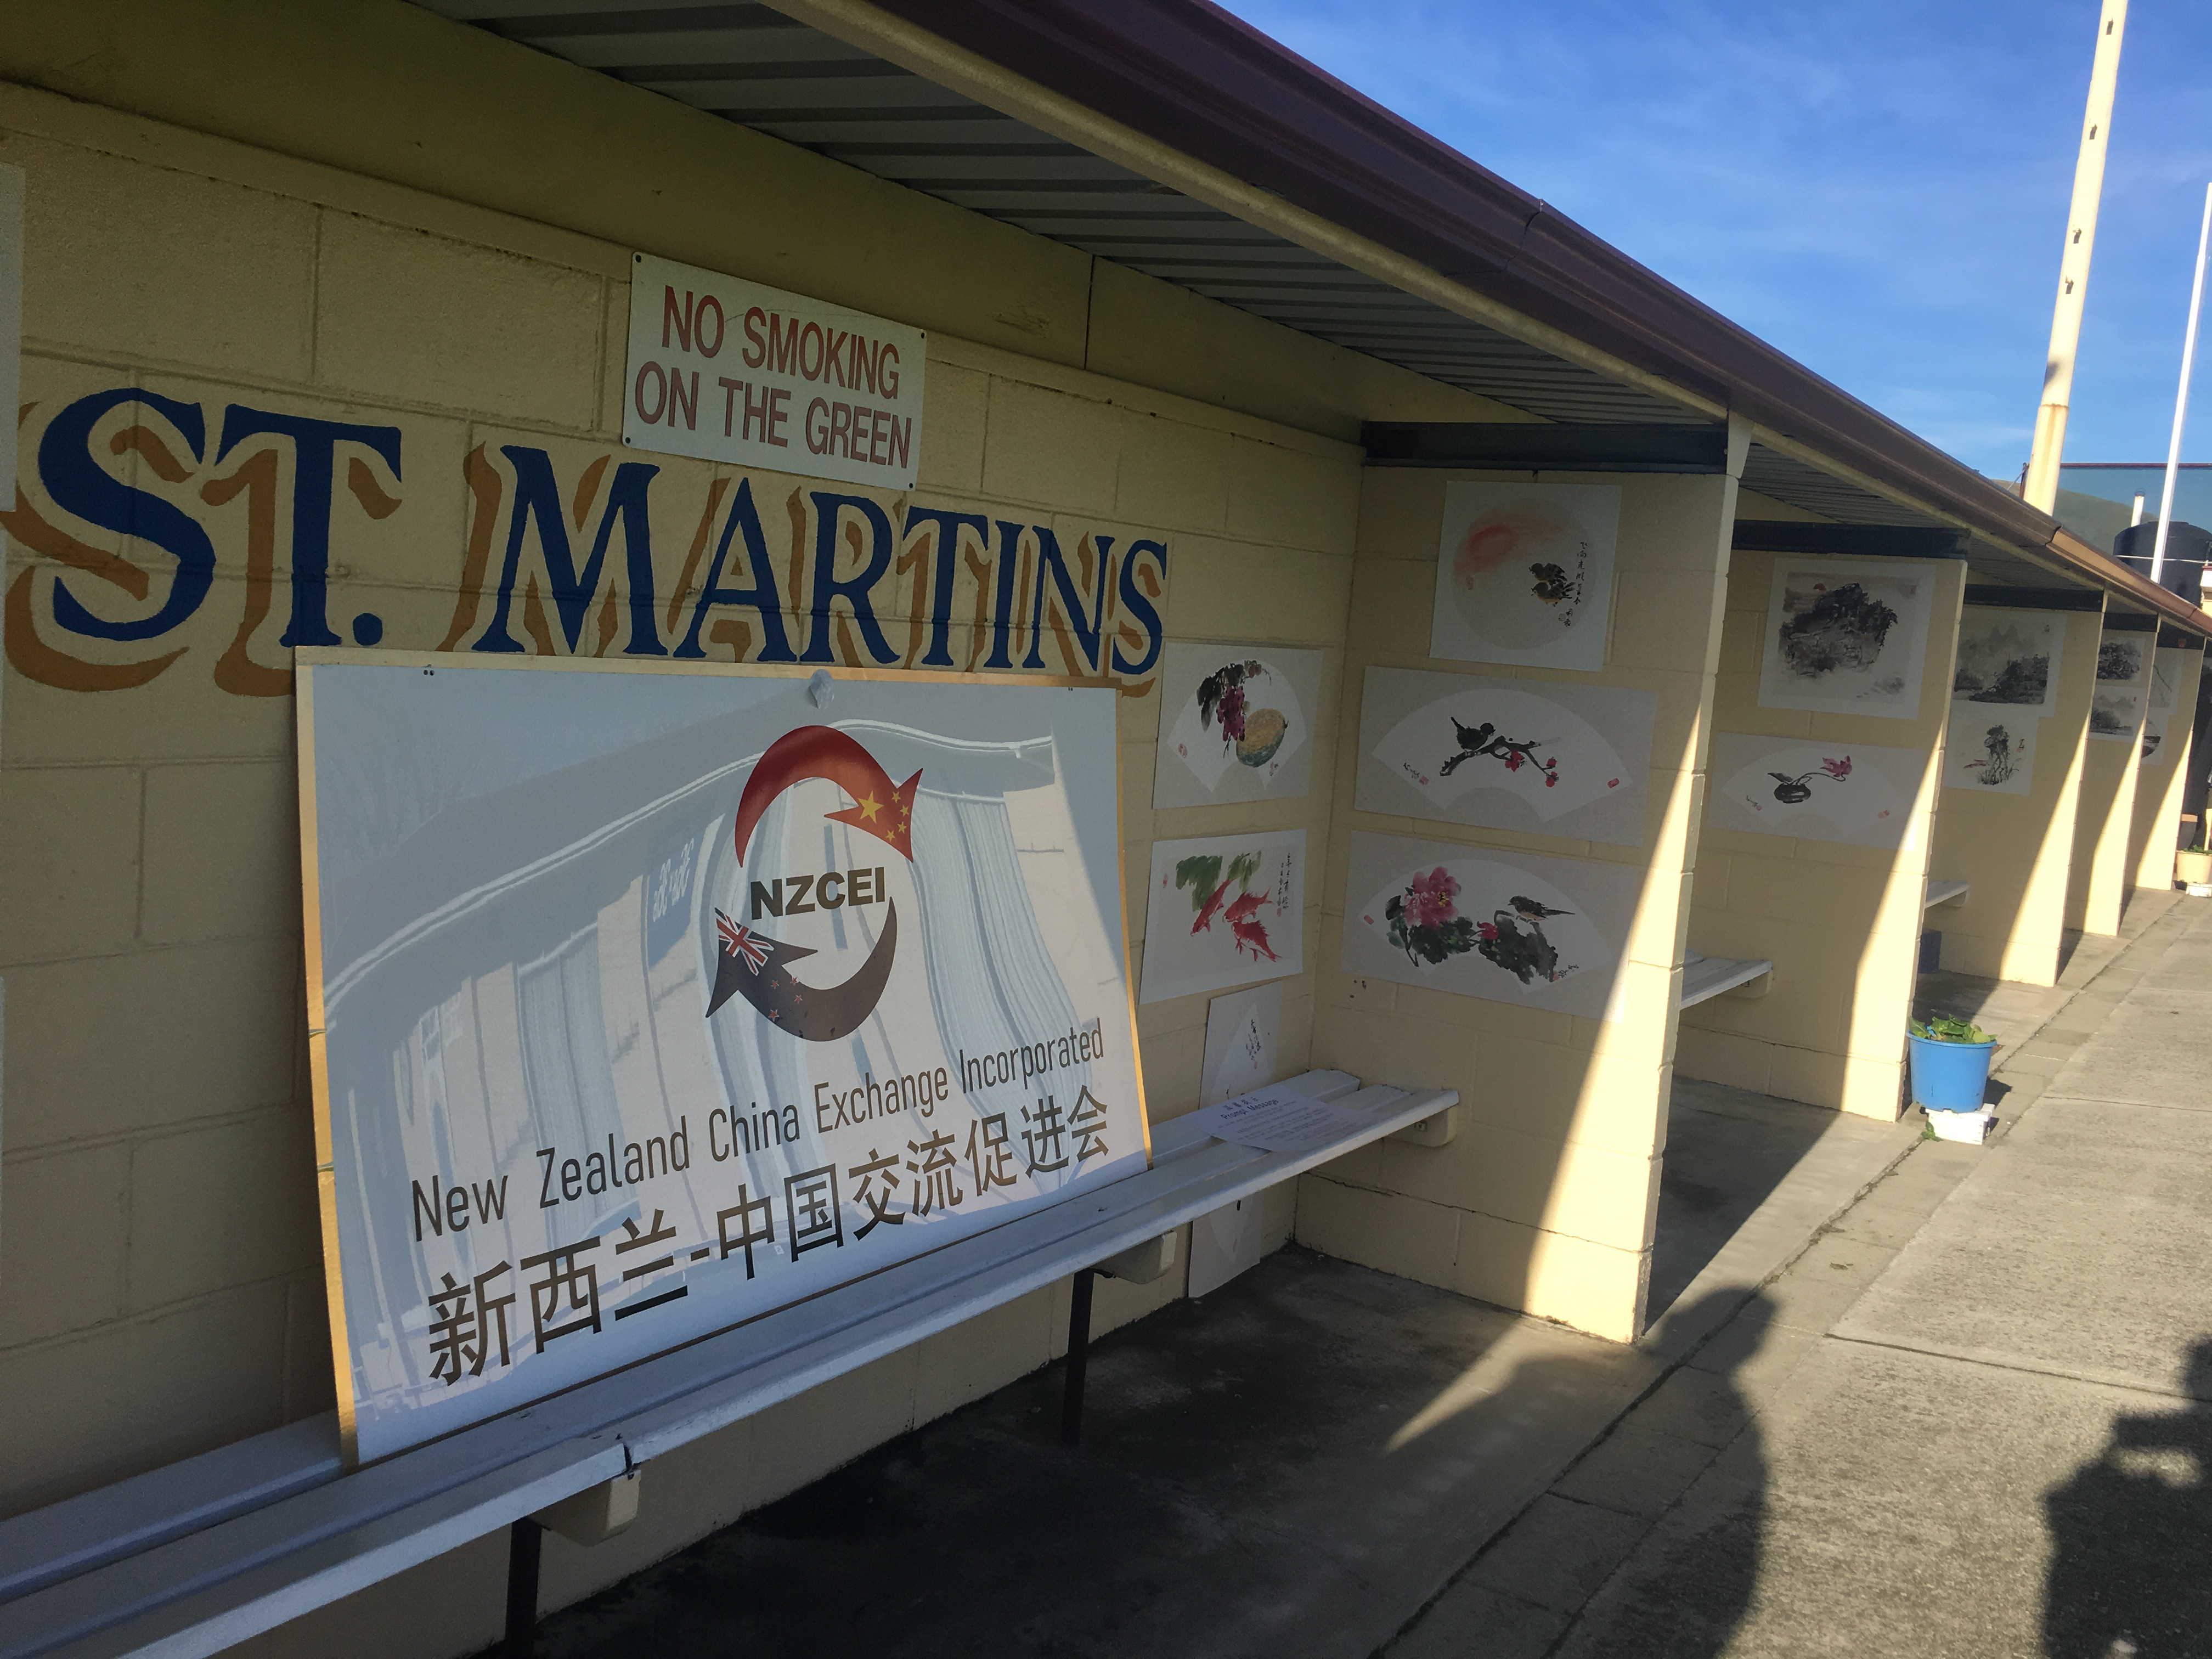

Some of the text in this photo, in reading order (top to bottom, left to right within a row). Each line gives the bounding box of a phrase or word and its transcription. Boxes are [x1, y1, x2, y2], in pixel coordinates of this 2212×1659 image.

[662, 284, 900, 399] NO SMOKING
[634, 361, 912, 469] ON THE GREEN
[37, 387, 1167, 675] ST. MARTINS
[750, 866, 885, 921] NZCEI
[411, 1017, 1104, 1242] New Zealand China Exchange Incorporated
